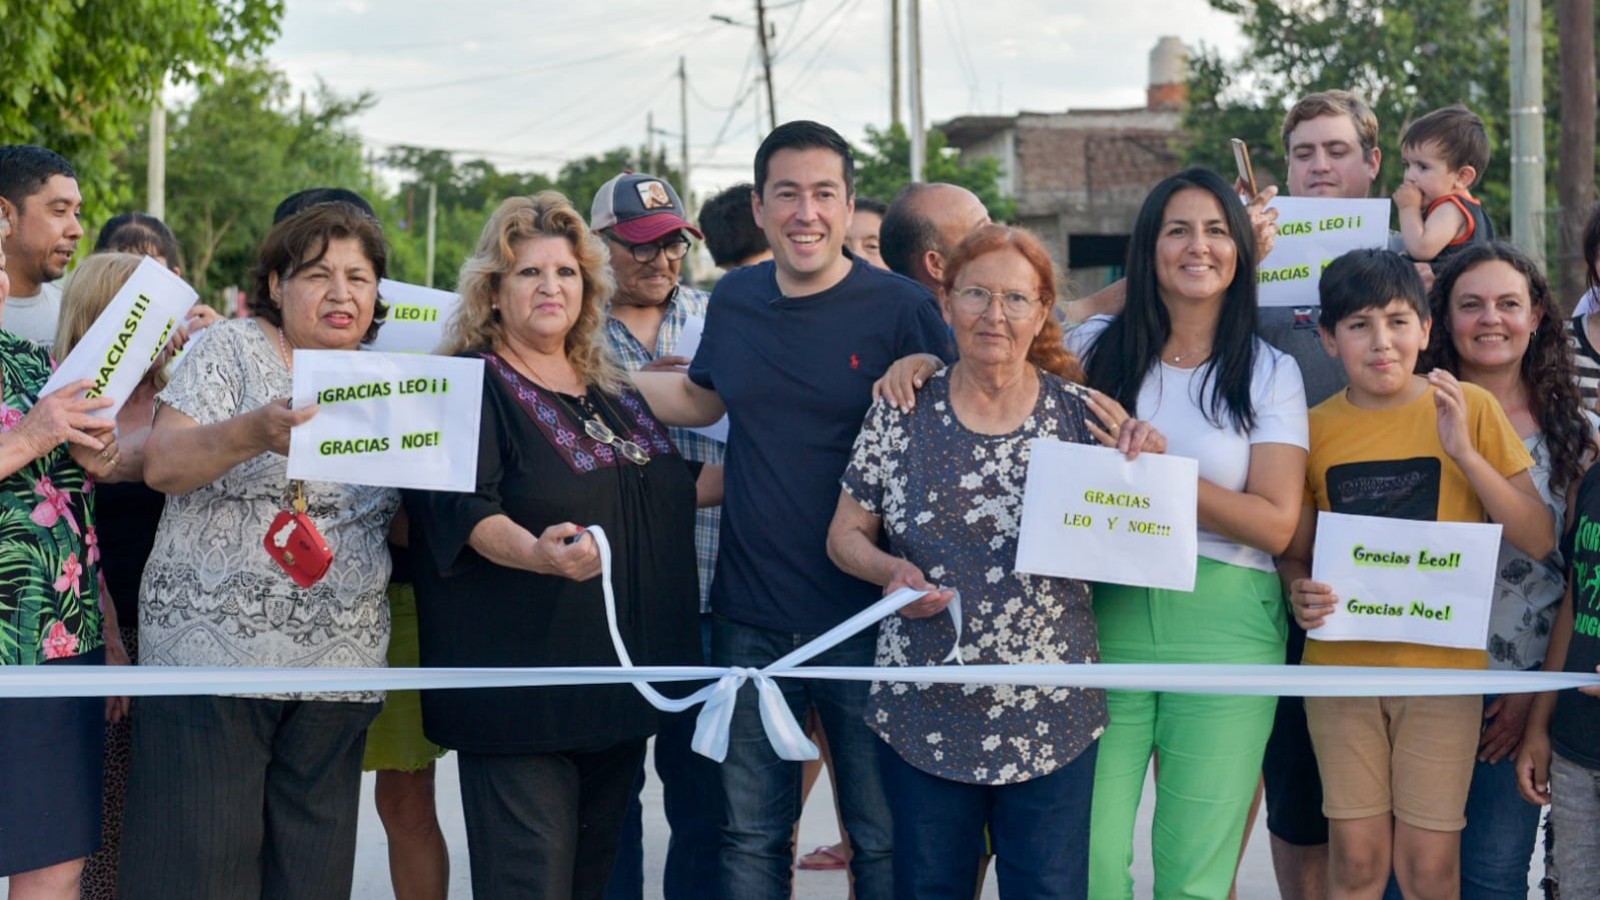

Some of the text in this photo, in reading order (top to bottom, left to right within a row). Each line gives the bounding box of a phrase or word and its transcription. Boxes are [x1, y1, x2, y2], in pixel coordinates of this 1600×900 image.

[320, 431, 439, 456] GRACIAS NOE!
[1084, 490, 1151, 509] GRACIAS
[1063, 513, 1171, 537] LEO Y NOE!!!
[1574, 514, 1600, 553] FOR
[1353, 546, 1461, 568] Gracias Leo!!
[1347, 599, 1451, 621] Gracias Noe!
